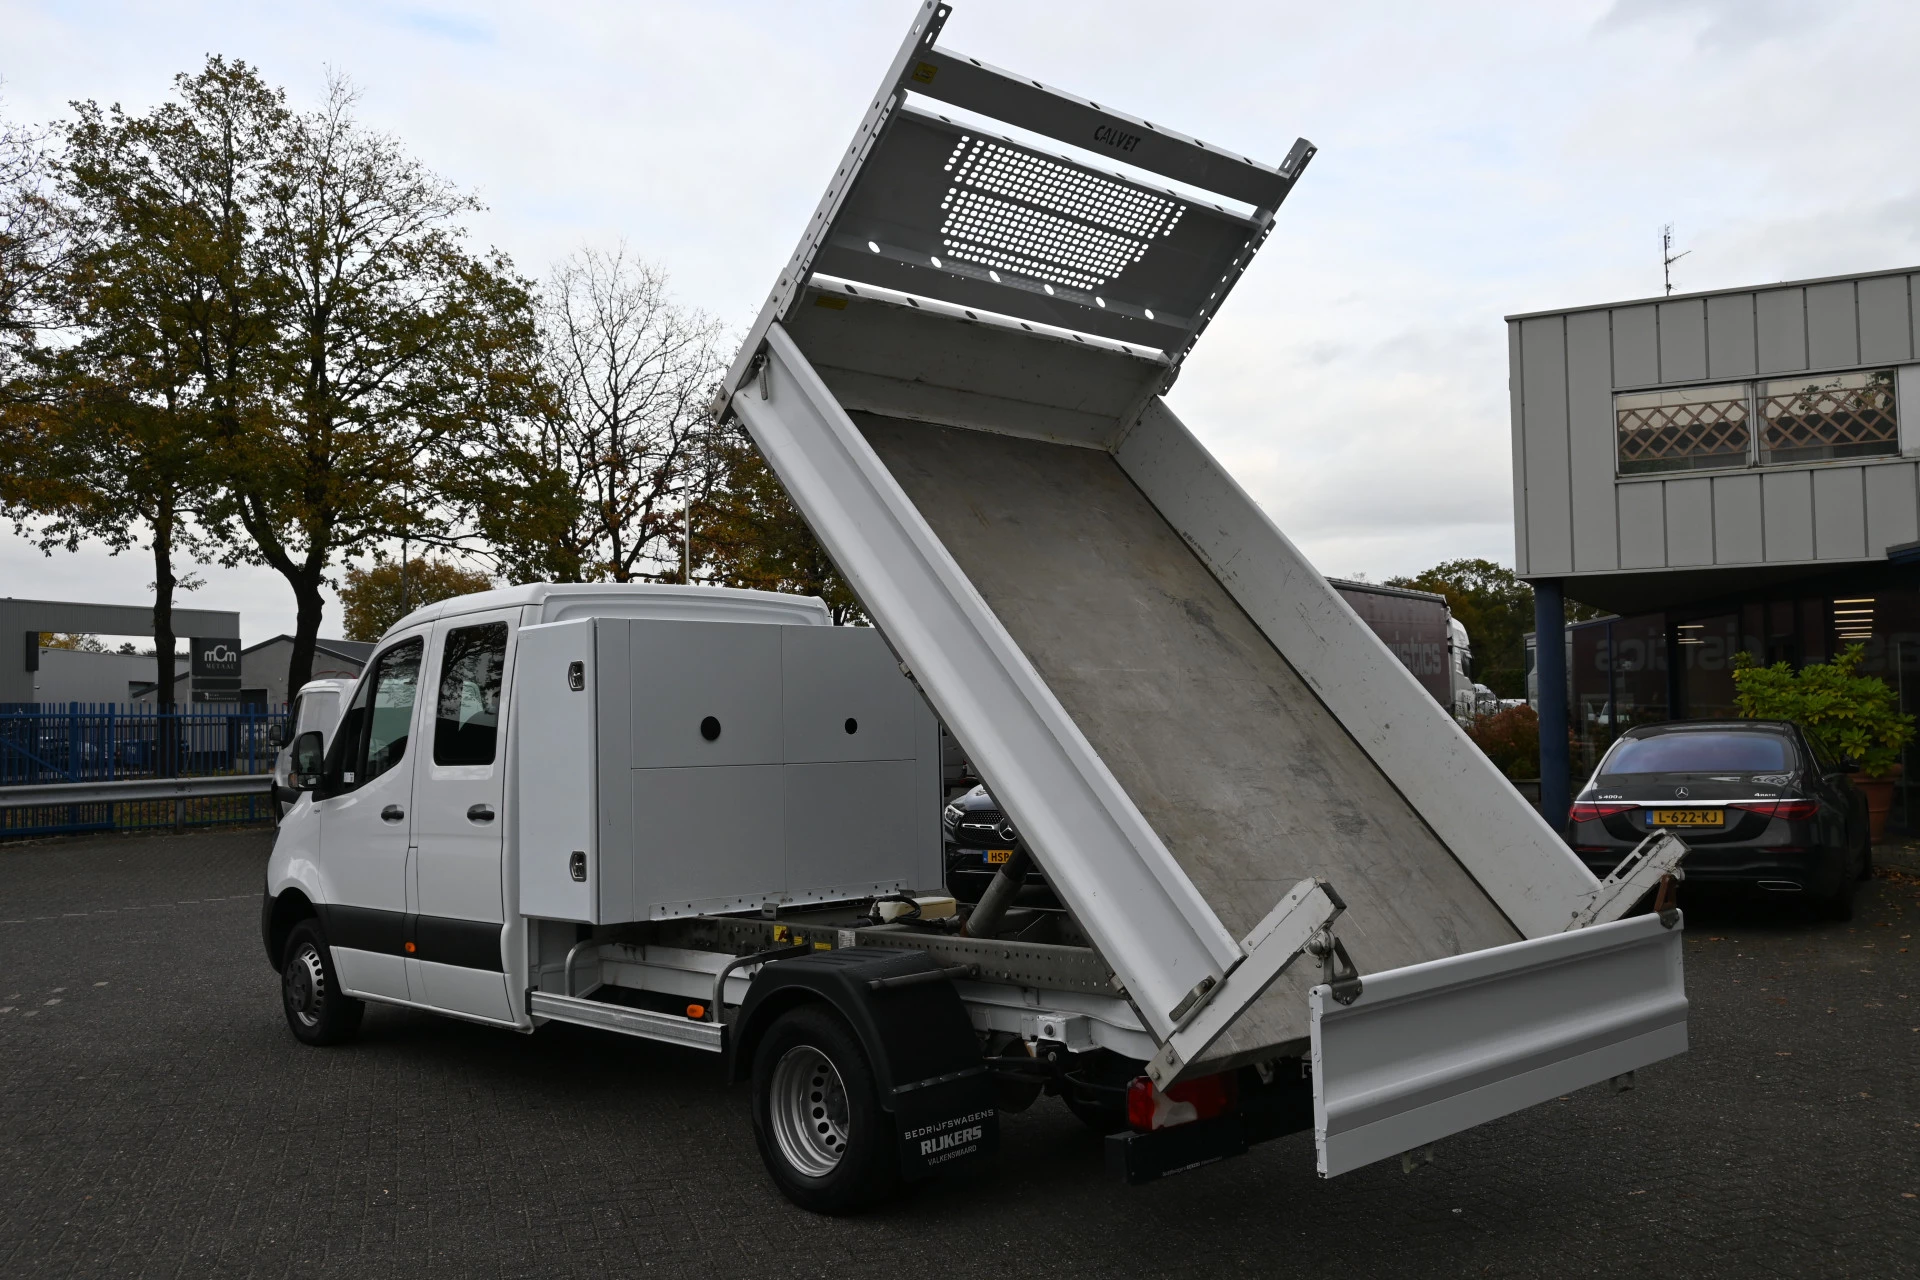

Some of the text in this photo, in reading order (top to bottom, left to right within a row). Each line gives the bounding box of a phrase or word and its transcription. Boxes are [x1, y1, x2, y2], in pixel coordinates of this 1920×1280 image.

[1094, 125, 1141, 152] CALVET
[1658, 811, 1717, 823] L-622-KJ
[904, 1108, 995, 1140] BEDRIJFSWAGENS
[919, 1125, 983, 1156] RIJKERS
[927, 1144, 977, 1166] VALKENSWAARD
